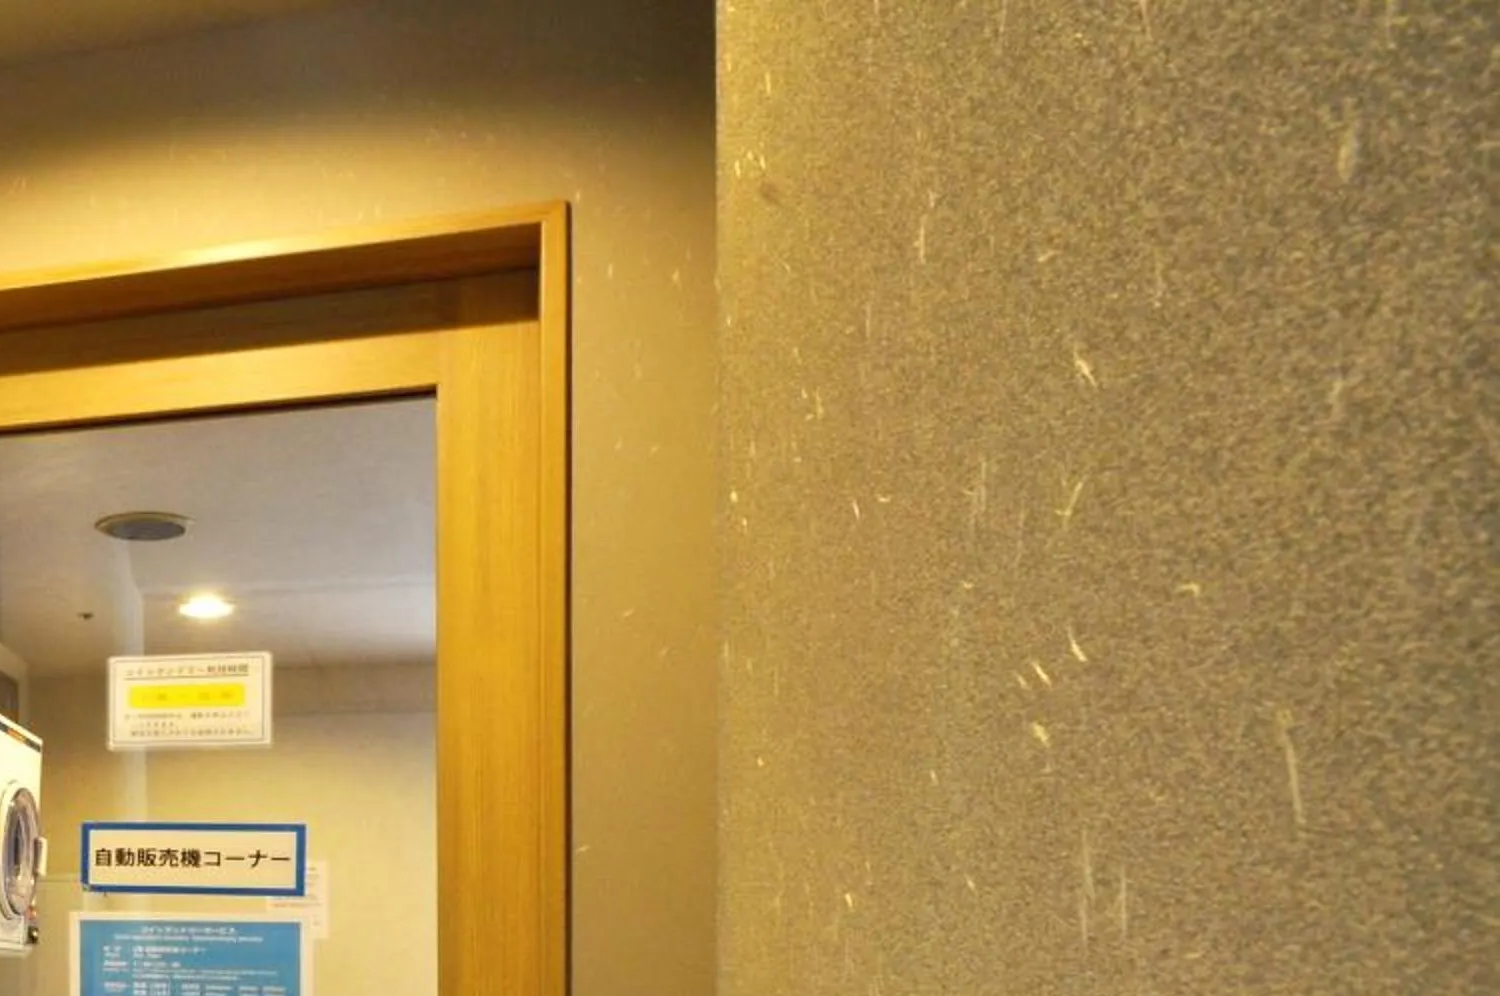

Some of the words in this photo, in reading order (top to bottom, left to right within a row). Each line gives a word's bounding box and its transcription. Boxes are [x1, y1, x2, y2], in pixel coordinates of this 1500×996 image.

[94, 848, 291, 868] 自動販売機コーナー
